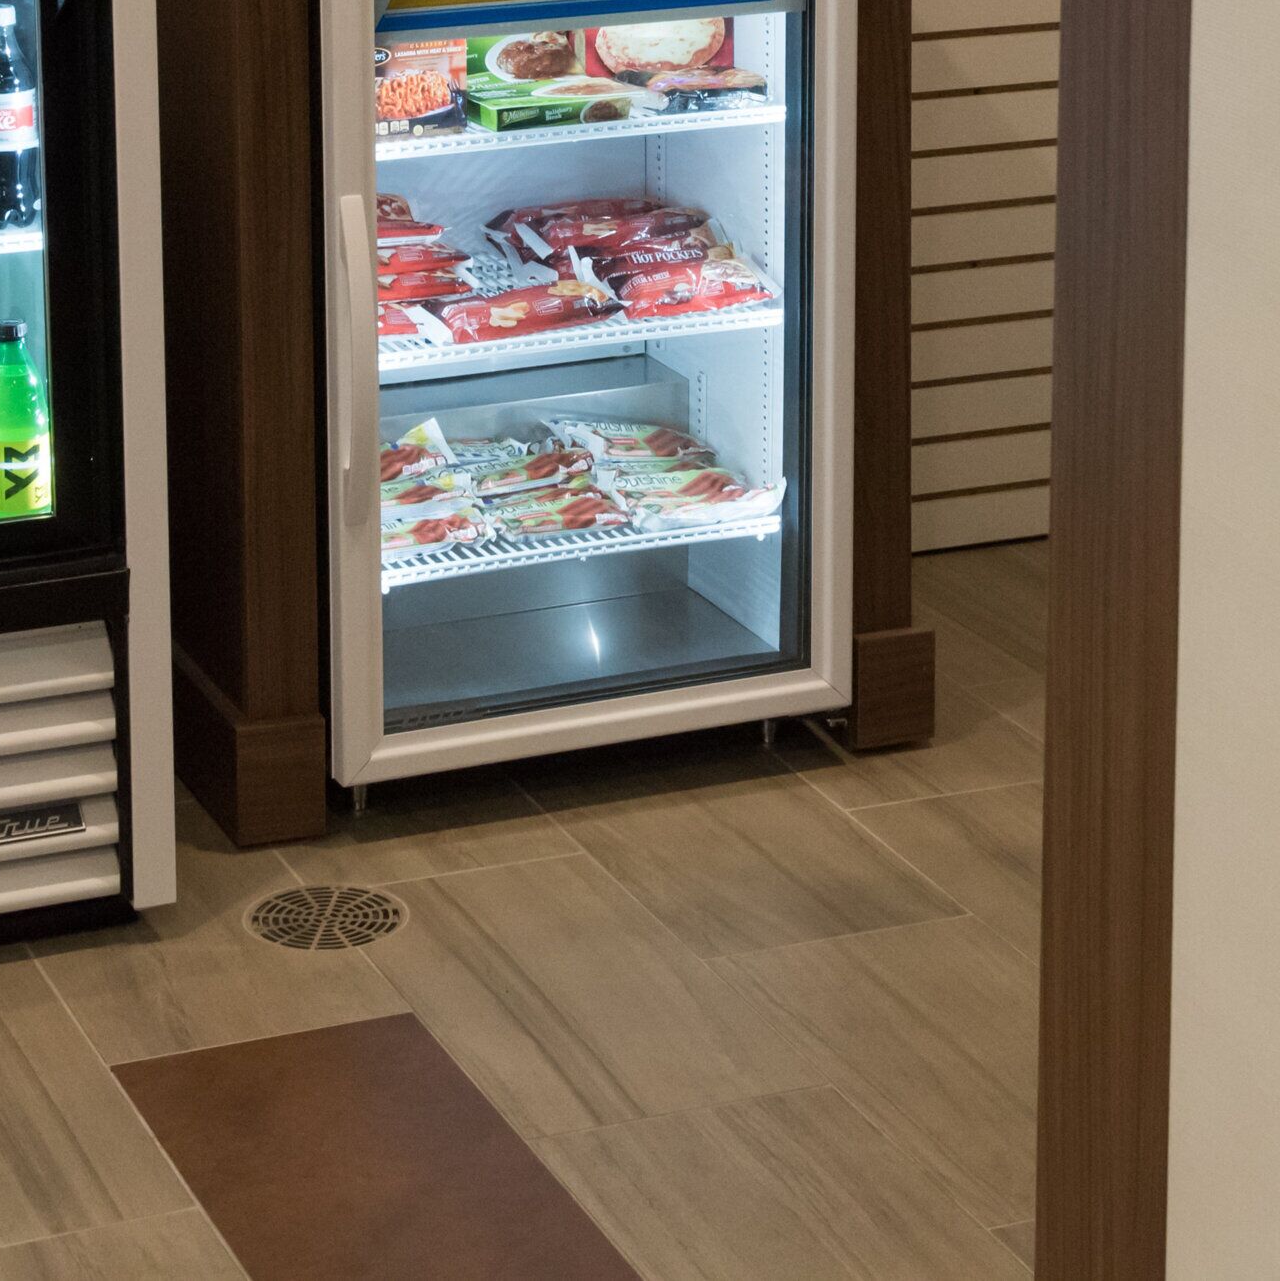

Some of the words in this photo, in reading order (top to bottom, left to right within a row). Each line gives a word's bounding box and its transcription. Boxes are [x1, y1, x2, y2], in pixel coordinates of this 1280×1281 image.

[630, 253, 654, 264] HOT
[655, 249, 704, 262] POCKETS
[615, 473, 682, 489] Outshine
